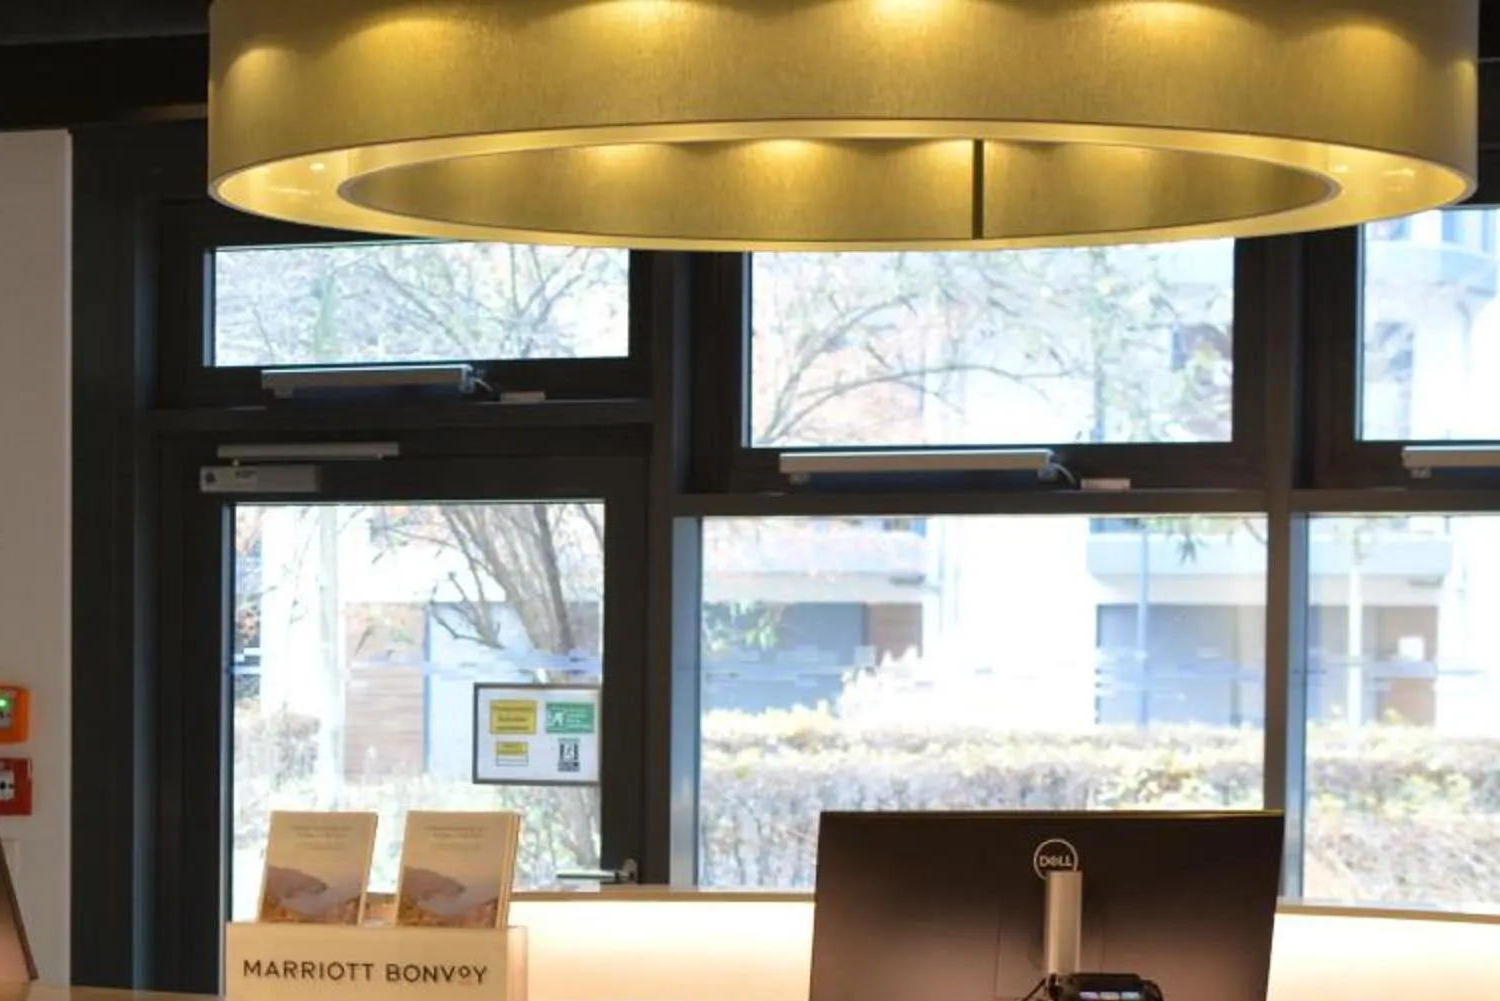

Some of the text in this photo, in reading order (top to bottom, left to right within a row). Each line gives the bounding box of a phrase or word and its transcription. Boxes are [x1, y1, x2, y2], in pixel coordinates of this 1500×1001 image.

[1039, 854, 1072, 867] DELL
[242, 958, 488, 985] MARRIOTT BONVOY
